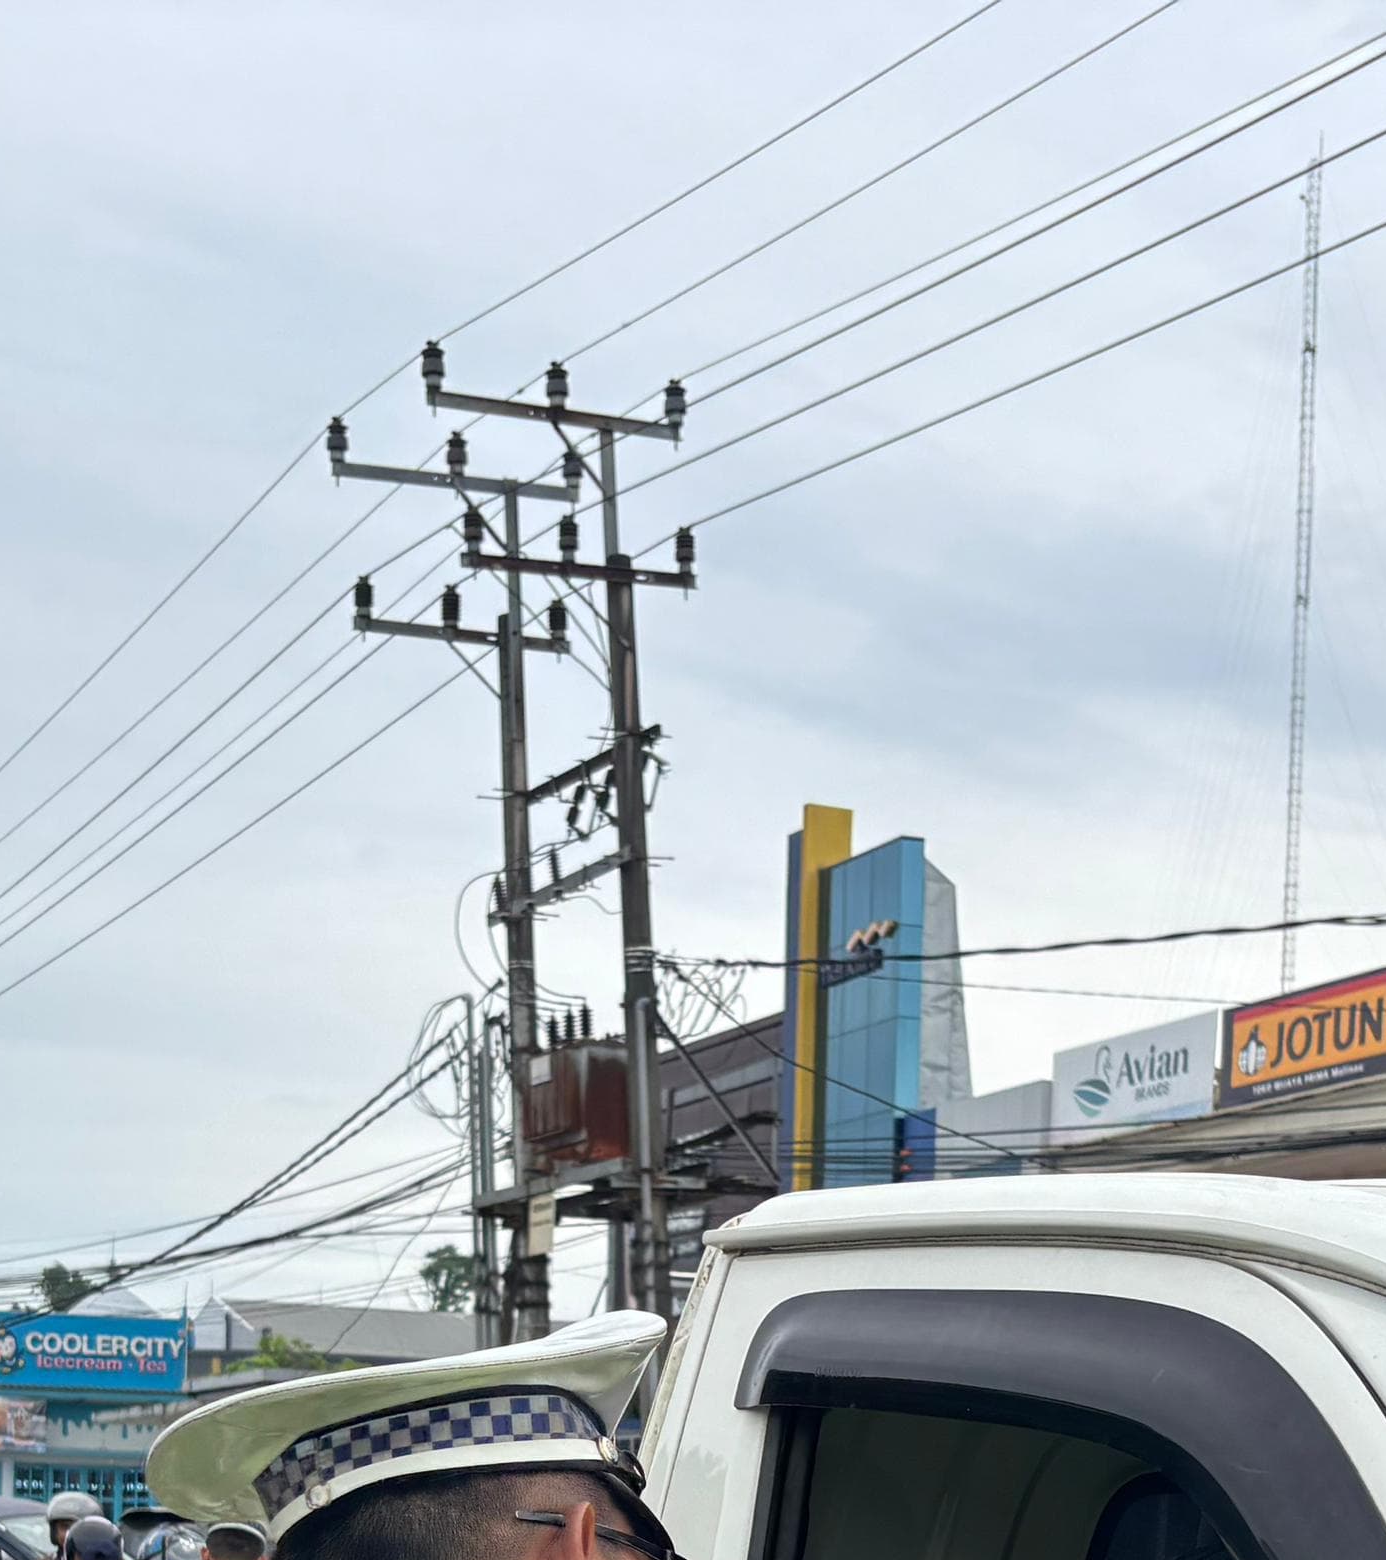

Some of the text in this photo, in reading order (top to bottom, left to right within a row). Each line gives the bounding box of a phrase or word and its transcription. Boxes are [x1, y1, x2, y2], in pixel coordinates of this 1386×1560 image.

[1270, 996, 1386, 1069] JOTUN
[1116, 1044, 1189, 1089] Avian
[1135, 1081, 1171, 1101] BRANDS
[37, 1354, 166, 1373] Icecream Tea
